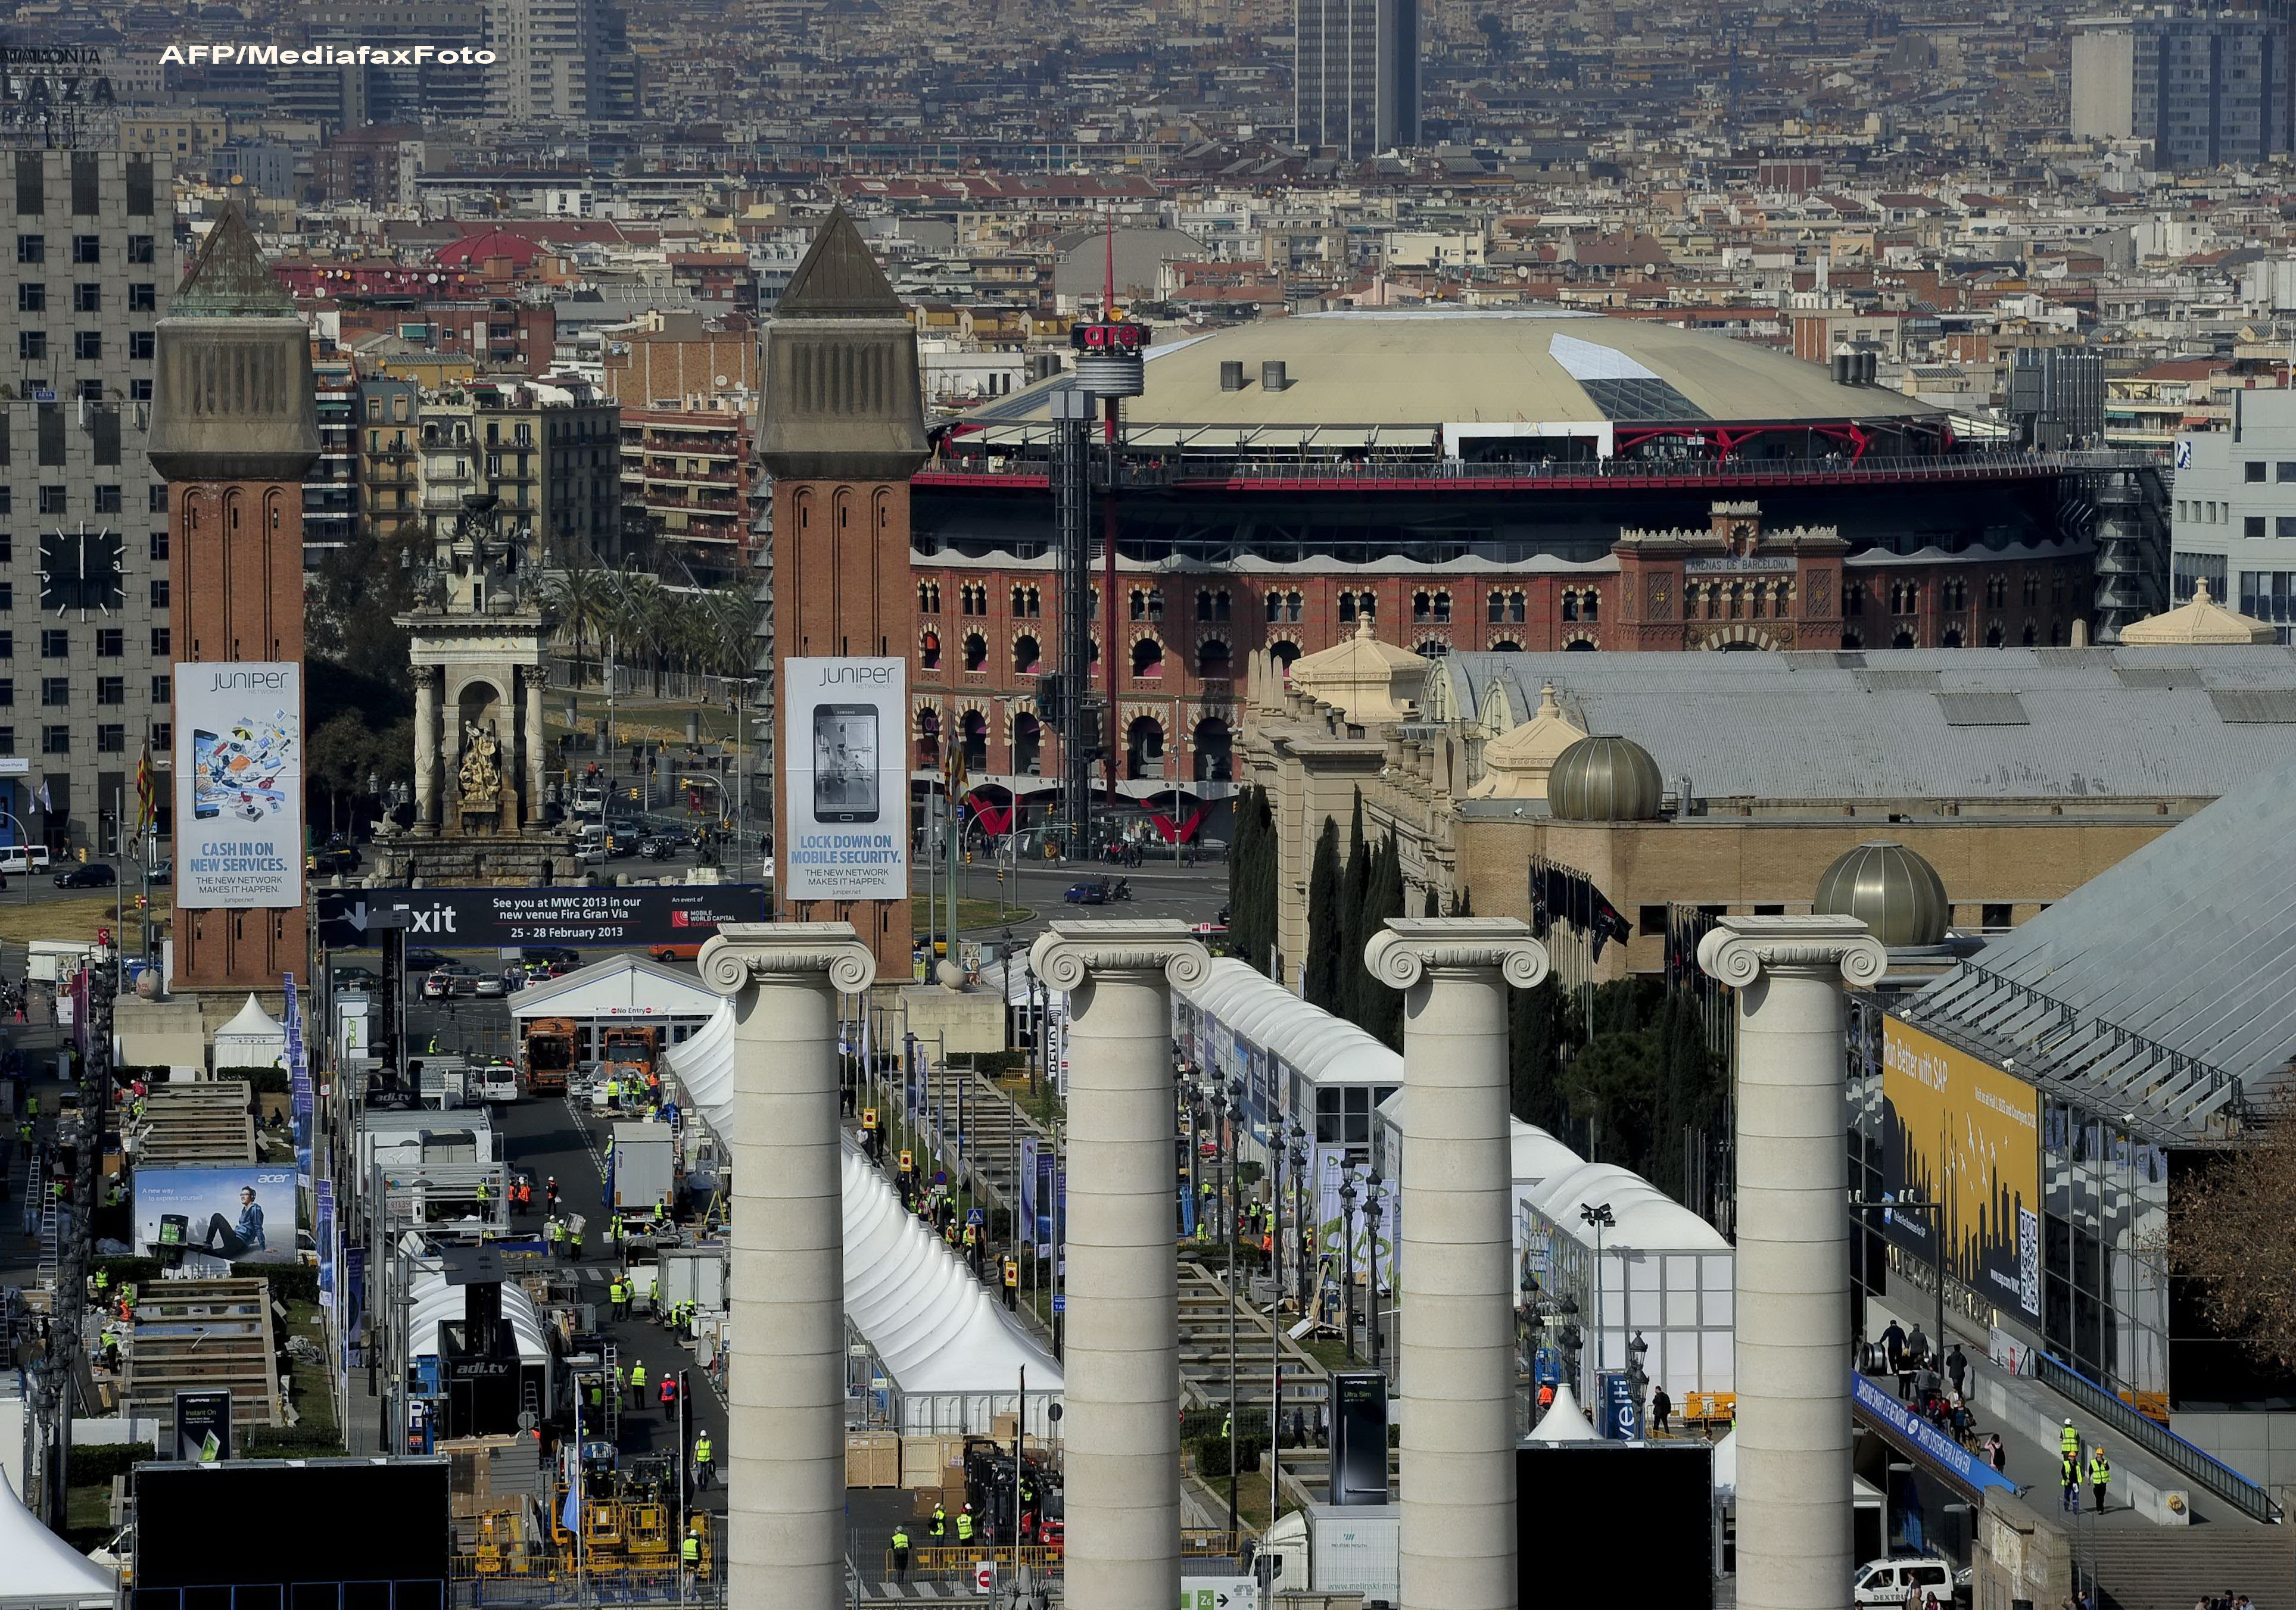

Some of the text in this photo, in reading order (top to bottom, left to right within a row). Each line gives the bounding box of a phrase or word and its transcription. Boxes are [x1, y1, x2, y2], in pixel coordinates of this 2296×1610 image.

[113, 560, 120, 570] 3
[1690, 558, 1789, 570] ARENAS DE BARCELONA
[42, 573, 51, 583] 9
[800, 835, 892, 848] LOCK DOWN ON
[202, 843, 274, 856] CASH IN ON
[791, 850, 902, 864] MOBILE SECURITY.
[191, 858, 288, 872] NEW SERVICES.
[195, 876, 214, 885] THE
[238, 876, 283, 884] NETWORK
[493, 897, 641, 910] See you at MWC 2013 in our
[500, 909, 628, 920] new venue Fira Gran Via
[511, 928, 524, 938] 25
[533, 928, 546, 938] 28
[549, 927, 596, 940] February
[598, 926, 624, 937] 2013
[348, 1018, 356, 1047] acer
[1883, 1031, 1948, 1094] Run Better with SAP
[375, 1092, 413, 1102] adi.tv
[257, 1174, 290, 1184] acer
[456, 1362, 509, 1374] adi.tv
[1856, 1379, 1874, 1406] SAMSUNG
[1872, 1389, 1886, 1414] SMART
[1889, 1402, 1908, 1430] NETWORKS
[1917, 1423, 1932, 1446] SMART
[1929, 1431, 1946, 1458] SYSTEMS
[1943, 1443, 1953, 1464] FOR
[1953, 1450, 1962, 1469] NEW
[1961, 1455, 1971, 1475] ERA
